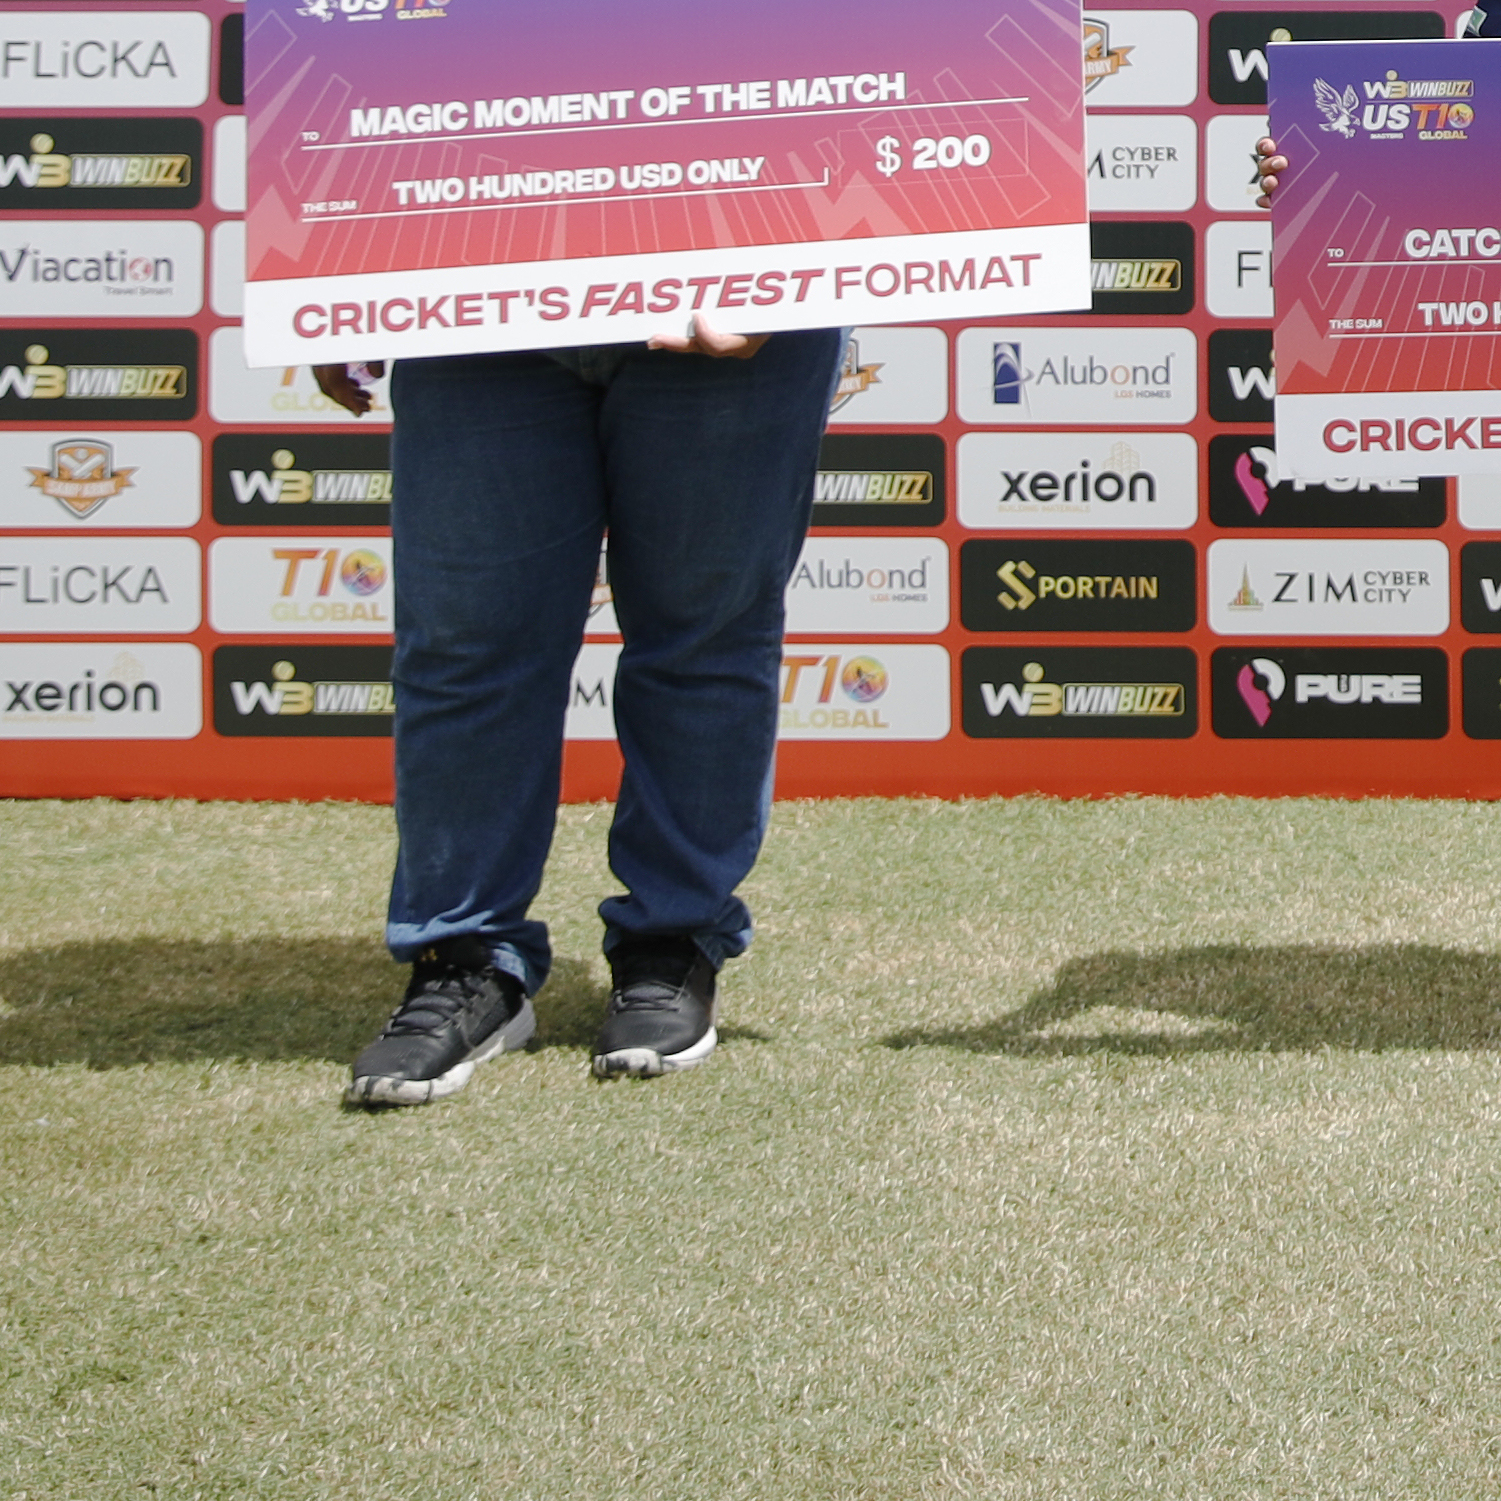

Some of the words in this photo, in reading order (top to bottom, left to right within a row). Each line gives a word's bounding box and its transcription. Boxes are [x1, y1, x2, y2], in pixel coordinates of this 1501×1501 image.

[396, 9, 447, 20] GLOBAL
[1410, 82, 1470, 97] WINBUZZ
[350, 102, 469, 138] MAGIC
[474, 90, 634, 129] MOMENT
[640, 87, 691, 115] OF
[696, 81, 771, 113] THE
[777, 71, 906, 108] MATCH
[1363, 104, 1411, 130] US
[302, 131, 320, 141] TO
[1418, 131, 1468, 140] GLOBAL
[876, 135, 901, 177] $
[912, 134, 990, 170] 200
[393, 178, 464, 205] TWO
[469, 167, 616, 200] HUNDRED
[620, 162, 683, 189] USD
[687, 156, 765, 184] ONLY
[302, 201, 328, 213] THE
[330, 200, 357, 212] SUM
[1328, 248, 1344, 258] TO
[293, 287, 570, 339] CRICKET'S
[580, 268, 825, 318] FASTEST
[835, 253, 1042, 300] FORMAT
[1329, 319, 1354, 329] THE
[1355, 318, 1383, 328] SUM
[1418, 302, 1489, 326] TWO
[998, 561, 1158, 611] SPORTAIN
[4, 671, 160, 712] xerion
[1295, 675, 1421, 704] PURE
